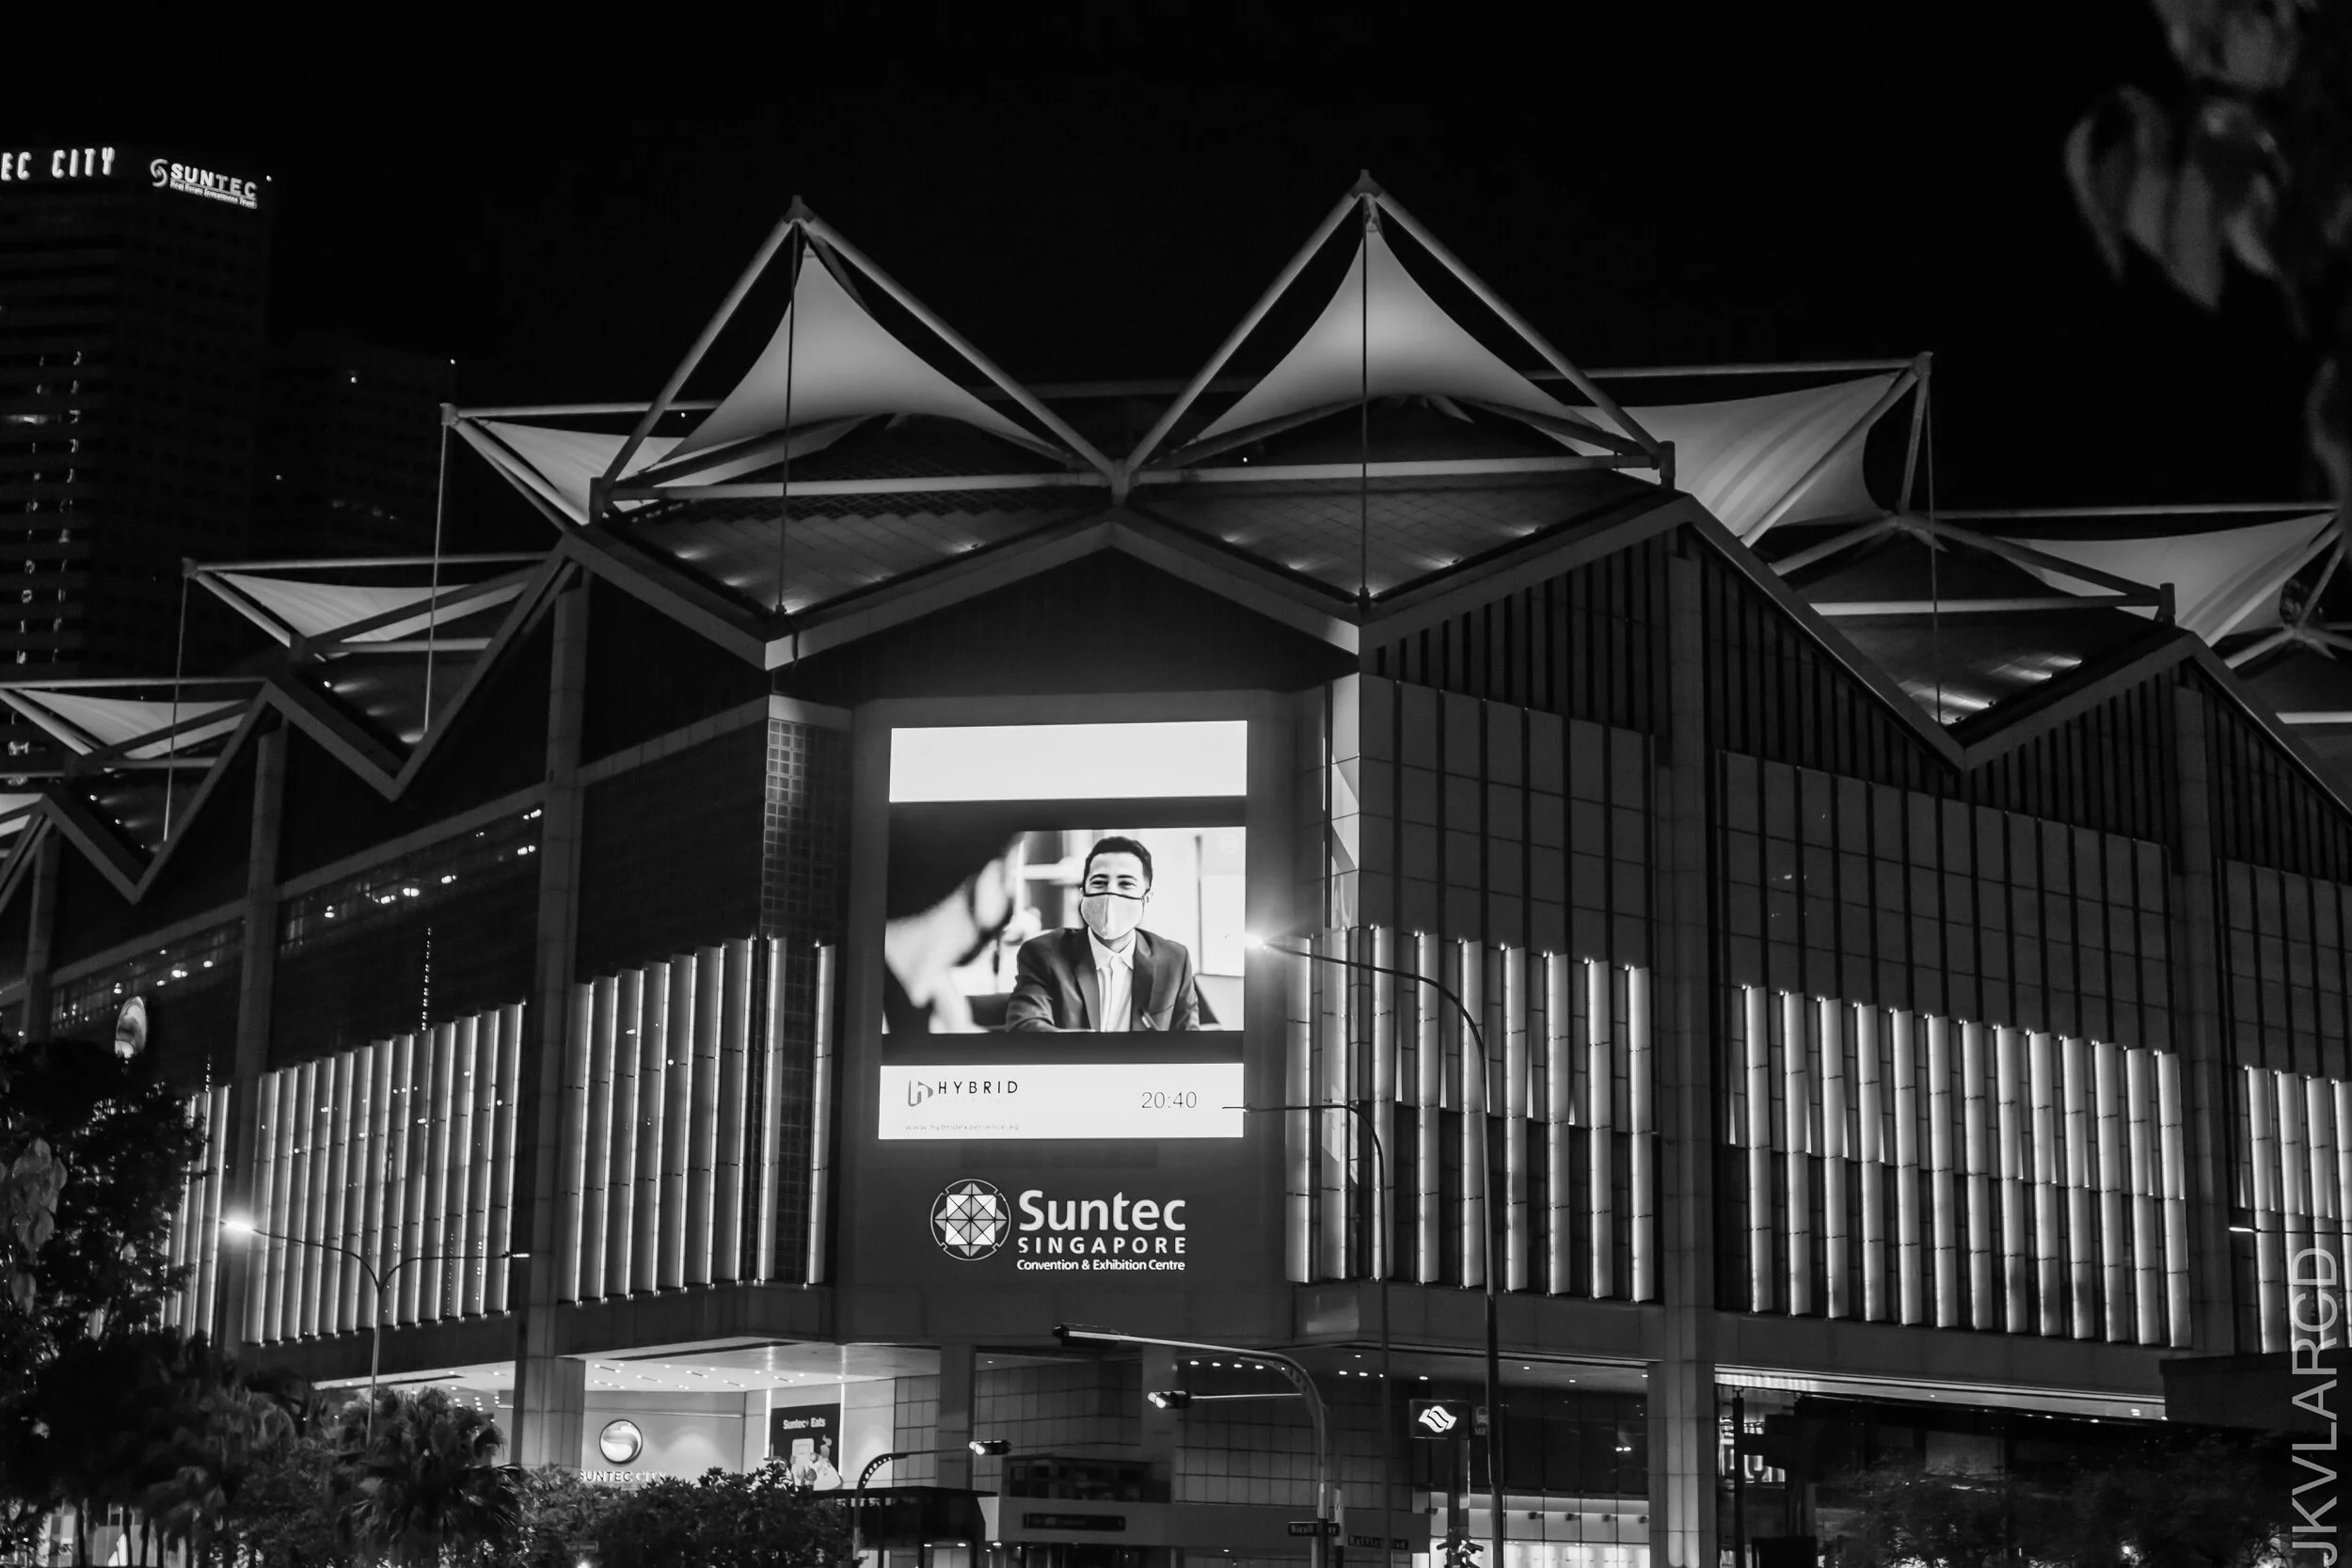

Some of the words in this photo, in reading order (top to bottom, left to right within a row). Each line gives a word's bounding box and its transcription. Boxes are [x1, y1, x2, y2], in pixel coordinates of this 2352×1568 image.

[1, 151, 32, 182] EC
[52, 147, 115, 179] CITY
[170, 163, 258, 198] SUNTEC
[938, 1081, 1018, 1094] HYBRID
[1141, 1091, 1198, 1109] 20:40
[1018, 1189, 1186, 1231] Suntec
[1018, 1237, 1186, 1254] SINGAPORE
[1016, 1259, 1079, 1271] Convention
[1081, 1259, 1090, 1271] &
[1092, 1259, 1147, 1271] Exhibition
[1148, 1259, 1185, 1271] Centre
[810, 1417, 826, 1428] Eats
